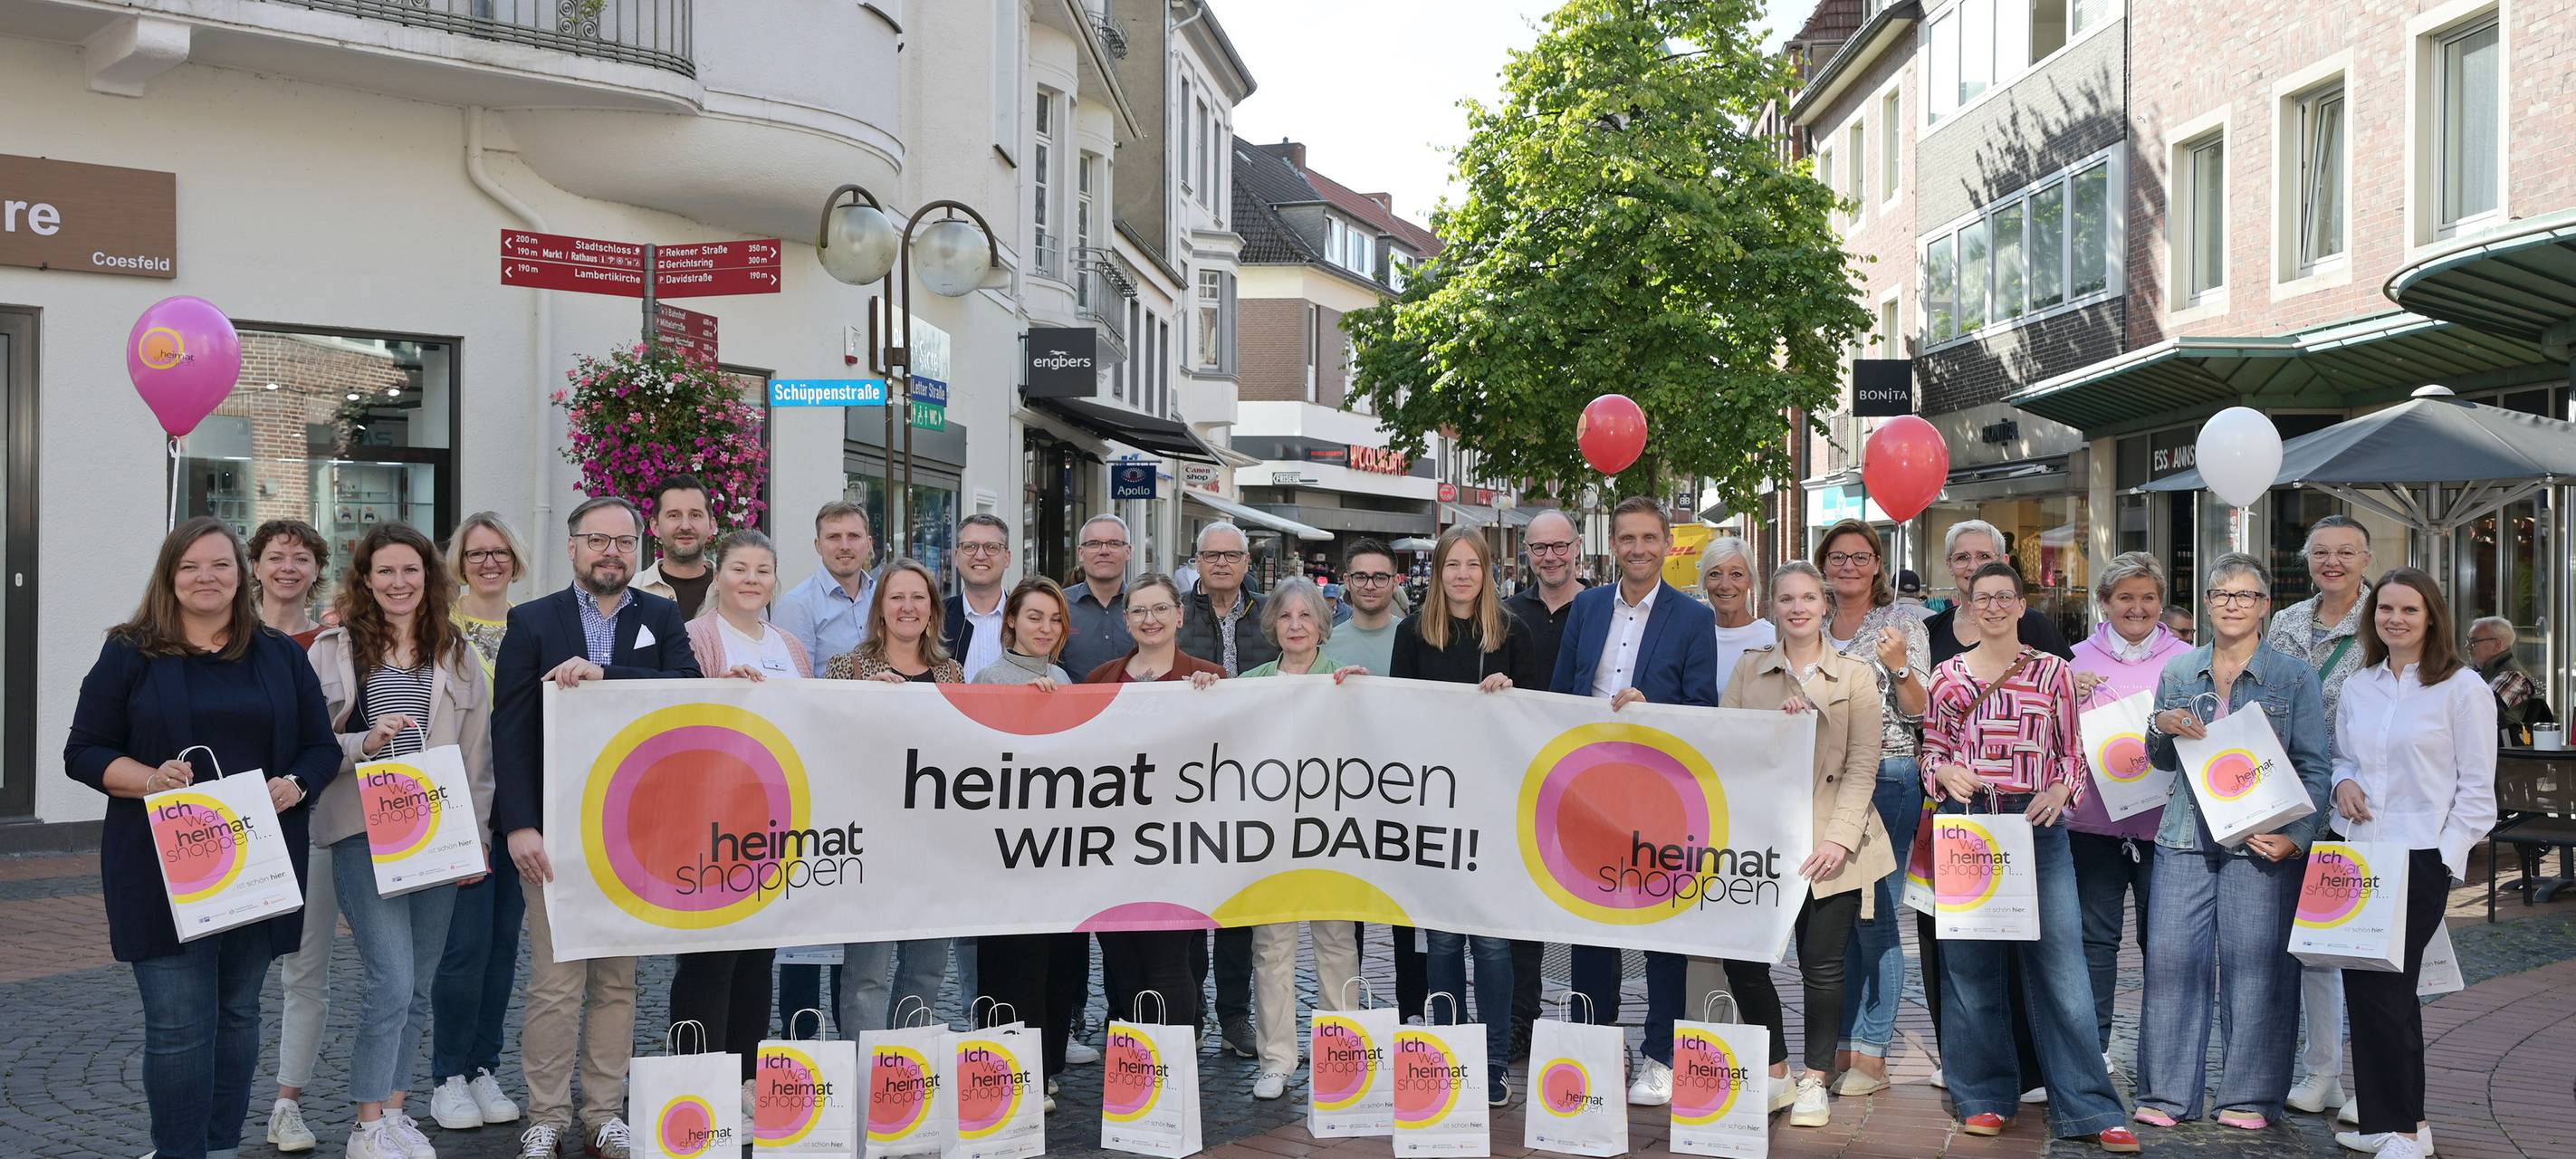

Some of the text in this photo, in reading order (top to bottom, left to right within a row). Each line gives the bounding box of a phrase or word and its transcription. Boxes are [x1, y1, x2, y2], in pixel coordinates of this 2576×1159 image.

[515, 235, 530, 244] 200
[575, 240, 632, 254] Stadtschloss
[517, 247, 531, 256] 190
[543, 248, 562, 260] Markt
[571, 252, 598, 263] Rathaus
[666, 244, 728, 257] Rekener Straße
[748, 244, 761, 253] 350
[92, 252, 169, 271] Coesfeld
[518, 263, 531, 273] 190
[666, 259, 713, 269] Gerichtsring
[748, 256, 760, 264] 300
[575, 269, 641, 283] Lambertikirche
[666, 273, 713, 283] Davidstraße
[750, 272, 760, 280] 190
[160, 350, 195, 361] heimat
[1033, 355, 1091, 369] engbers
[775, 383, 880, 405] Schüppenstraße
[912, 381, 945, 400] Letter Straße
[929, 408, 937, 426] WC
[1185, 466, 1211, 474] Canon
[1117, 484, 1151, 497] Apollo
[904, 743, 1456, 812] heimat shoppen
[2235, 758, 2274, 783] heimat
[365, 770, 396, 788] Ich
[388, 776, 423, 795] war
[379, 786, 448, 811] heimat
[158, 800, 193, 822] Ich
[183, 807, 224, 827] war
[369, 799, 464, 827] shoppen...
[176, 815, 254, 847] heimat
[1941, 824, 1967, 839] Ich
[167, 829, 273, 863] shoppen...
[711, 819, 864, 863] heimat
[994, 817, 1480, 872] WIR SIND DABEI!
[1958, 838, 1991, 850] war
[1633, 830, 1780, 878] heimat
[1949, 849, 2011, 865] heimat
[2317, 850, 2341, 864] Ich
[270, 871, 287, 881] hier.
[675, 852, 863, 901] shoppen
[1939, 863, 2023, 879] shoppen...
[2332, 862, 2363, 875] war
[1597, 857, 1779, 911] shoppen
[2320, 873, 2380, 888] heimat
[2304, 883, 2389, 901] shoppen...
[1320, 1021, 1344, 1038] Ich
[1113, 1032, 1135, 1048] Ich
[1336, 1035, 1365, 1048] war
[1401, 1037, 1425, 1053] Ich
[1682, 1034, 1707, 1051] Ich
[765, 1053, 791, 1068] Ich
[879, 1052, 904, 1068] Ich
[964, 1047, 989, 1063] Ich
[1126, 1048, 1155, 1060] war
[1327, 1046, 1384, 1062] heimat
[1416, 1051, 1449, 1064] war
[1698, 1049, 1730, 1064] war
[895, 1063, 924, 1078] war
[981, 1058, 1011, 1073] war
[1118, 1058, 1169, 1078] heimat
[1317, 1059, 1394, 1076] shoppen...
[1409, 1062, 1468, 1078] heimat
[1688, 1060, 1748, 1080] heimat
[781, 1067, 814, 1081] war
[972, 1070, 1030, 1087] heimat
[1107, 1069, 1177, 1091] shoppen...
[771, 1079, 833, 1096] heimat
[886, 1073, 940, 1092] heimat
[1397, 1076, 1480, 1094] shoppen...
[1676, 1071, 1759, 1094] shoppen...
[962, 1083, 1039, 1102] shoppen...
[1566, 1089, 1604, 1106] heimat
[759, 1092, 845, 1112] shoppen...
[688, 1126, 732, 1141] heimat
[679, 1135, 732, 1152] shoppen
